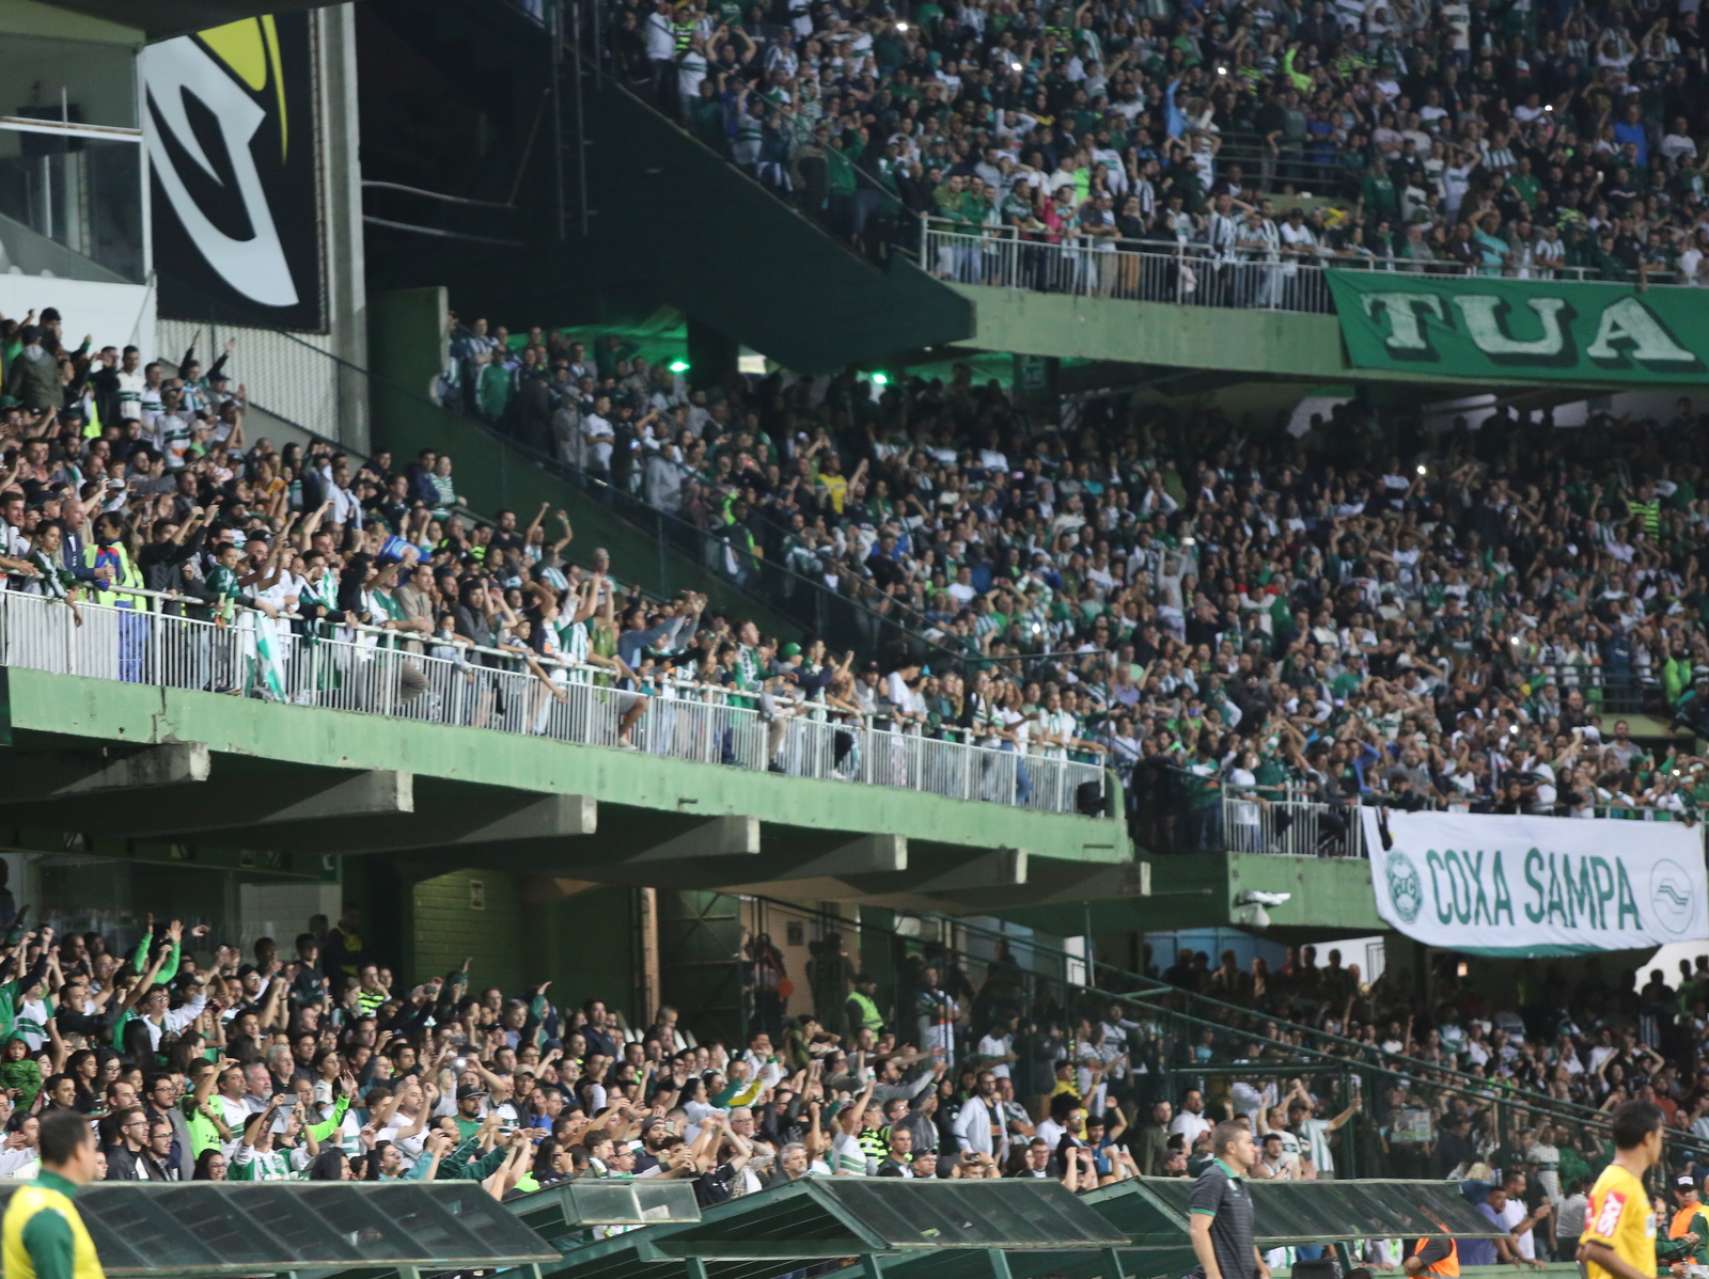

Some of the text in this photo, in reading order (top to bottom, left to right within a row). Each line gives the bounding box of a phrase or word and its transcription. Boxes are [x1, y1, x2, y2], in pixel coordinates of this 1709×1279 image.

[1360, 293, 1697, 363] TUA
[1426, 847, 1643, 931] COXA SAMPA
